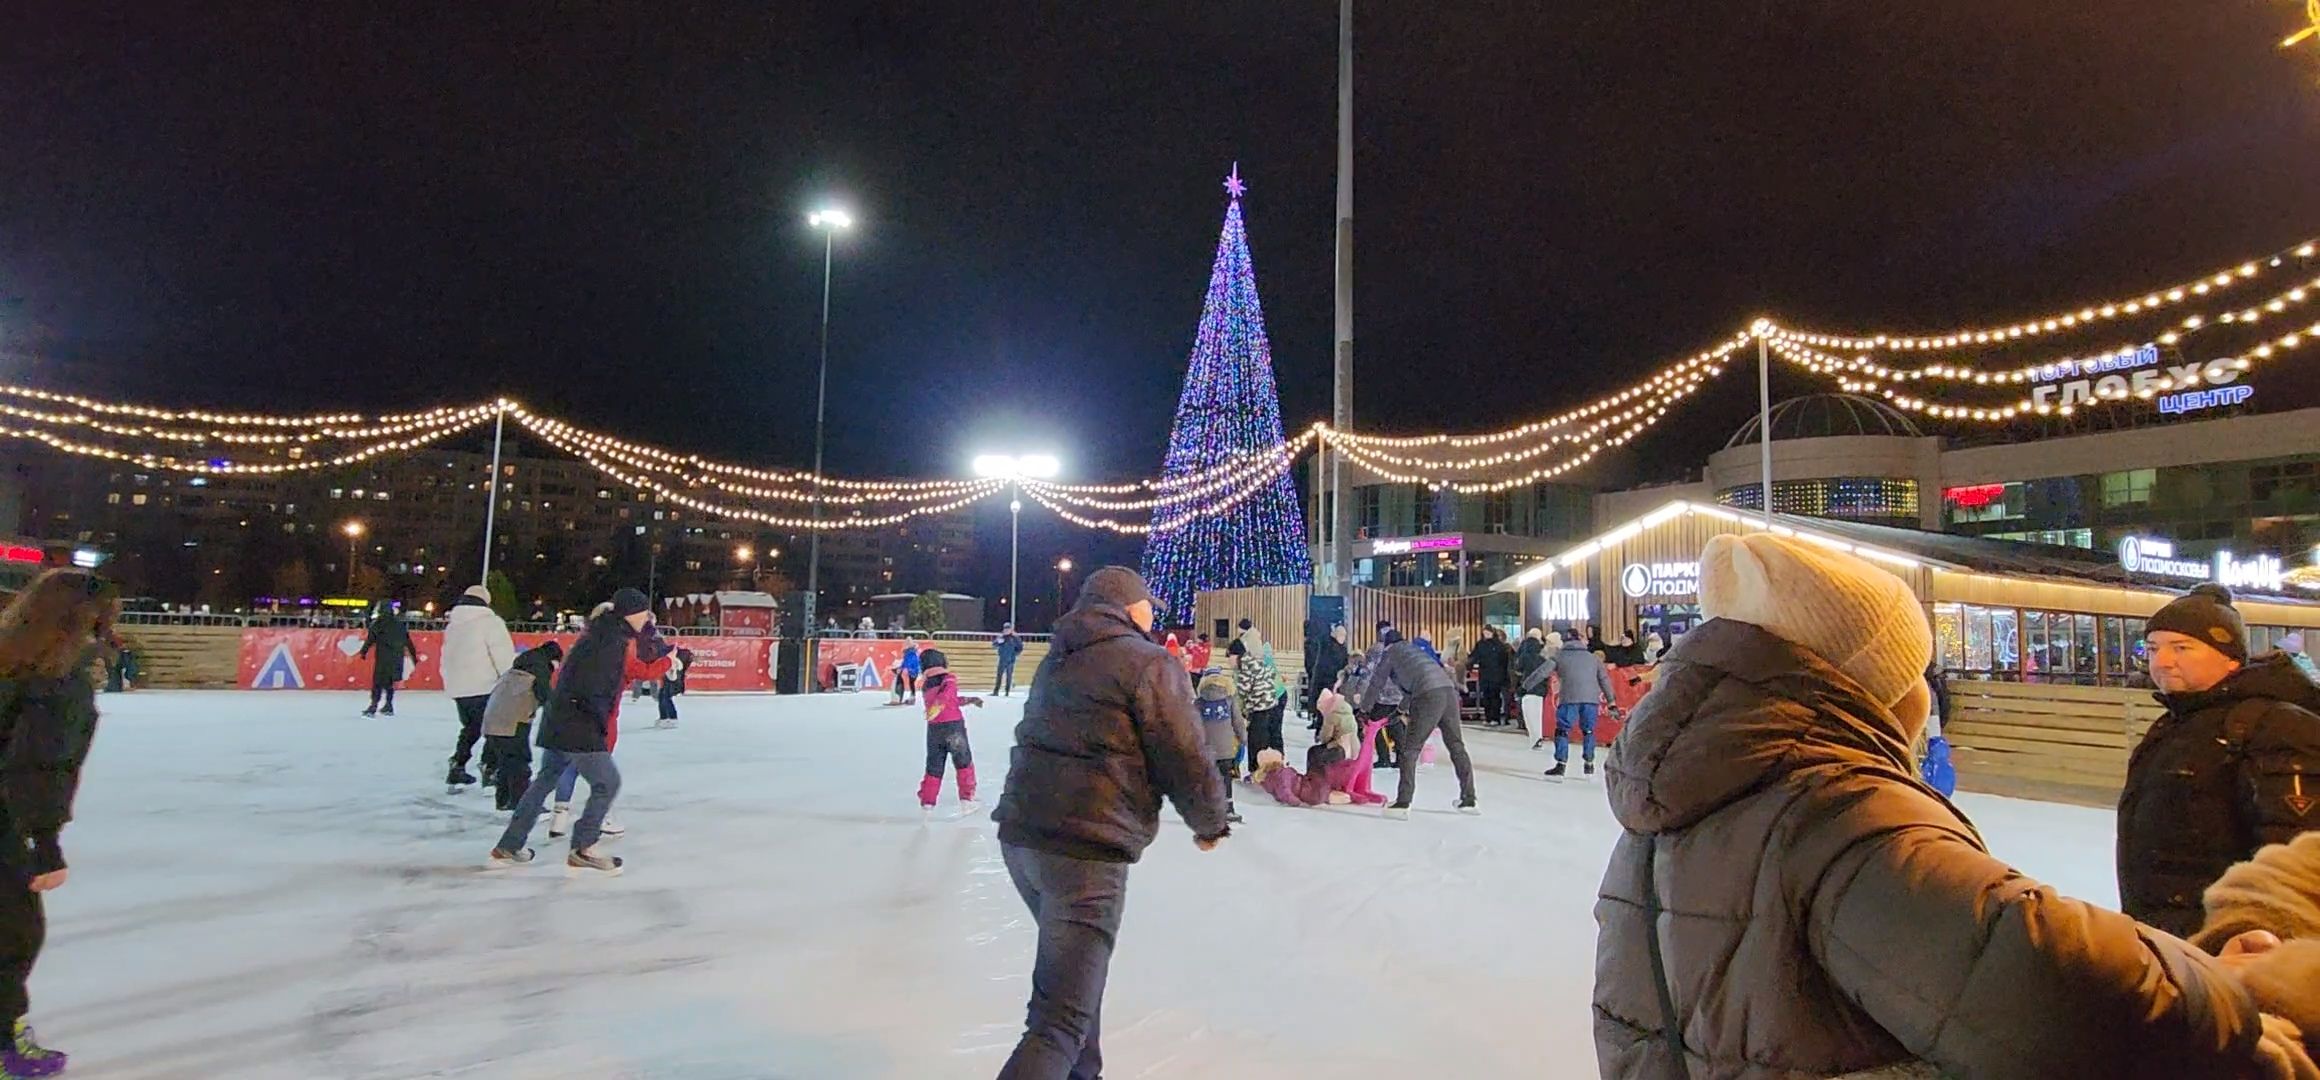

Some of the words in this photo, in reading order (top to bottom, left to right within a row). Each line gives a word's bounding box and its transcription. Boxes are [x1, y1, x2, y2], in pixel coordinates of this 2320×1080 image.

[2031, 343, 2158, 382] ТОРГОВЫЙ
[2160, 385, 2253, 413] ЦЕНТР
[2141, 557, 2209, 578] ПОДМОСКОВЬЯ
[1652, 580, 1700, 595] ПОДМ
[1542, 589, 1589, 620] КАТОК
